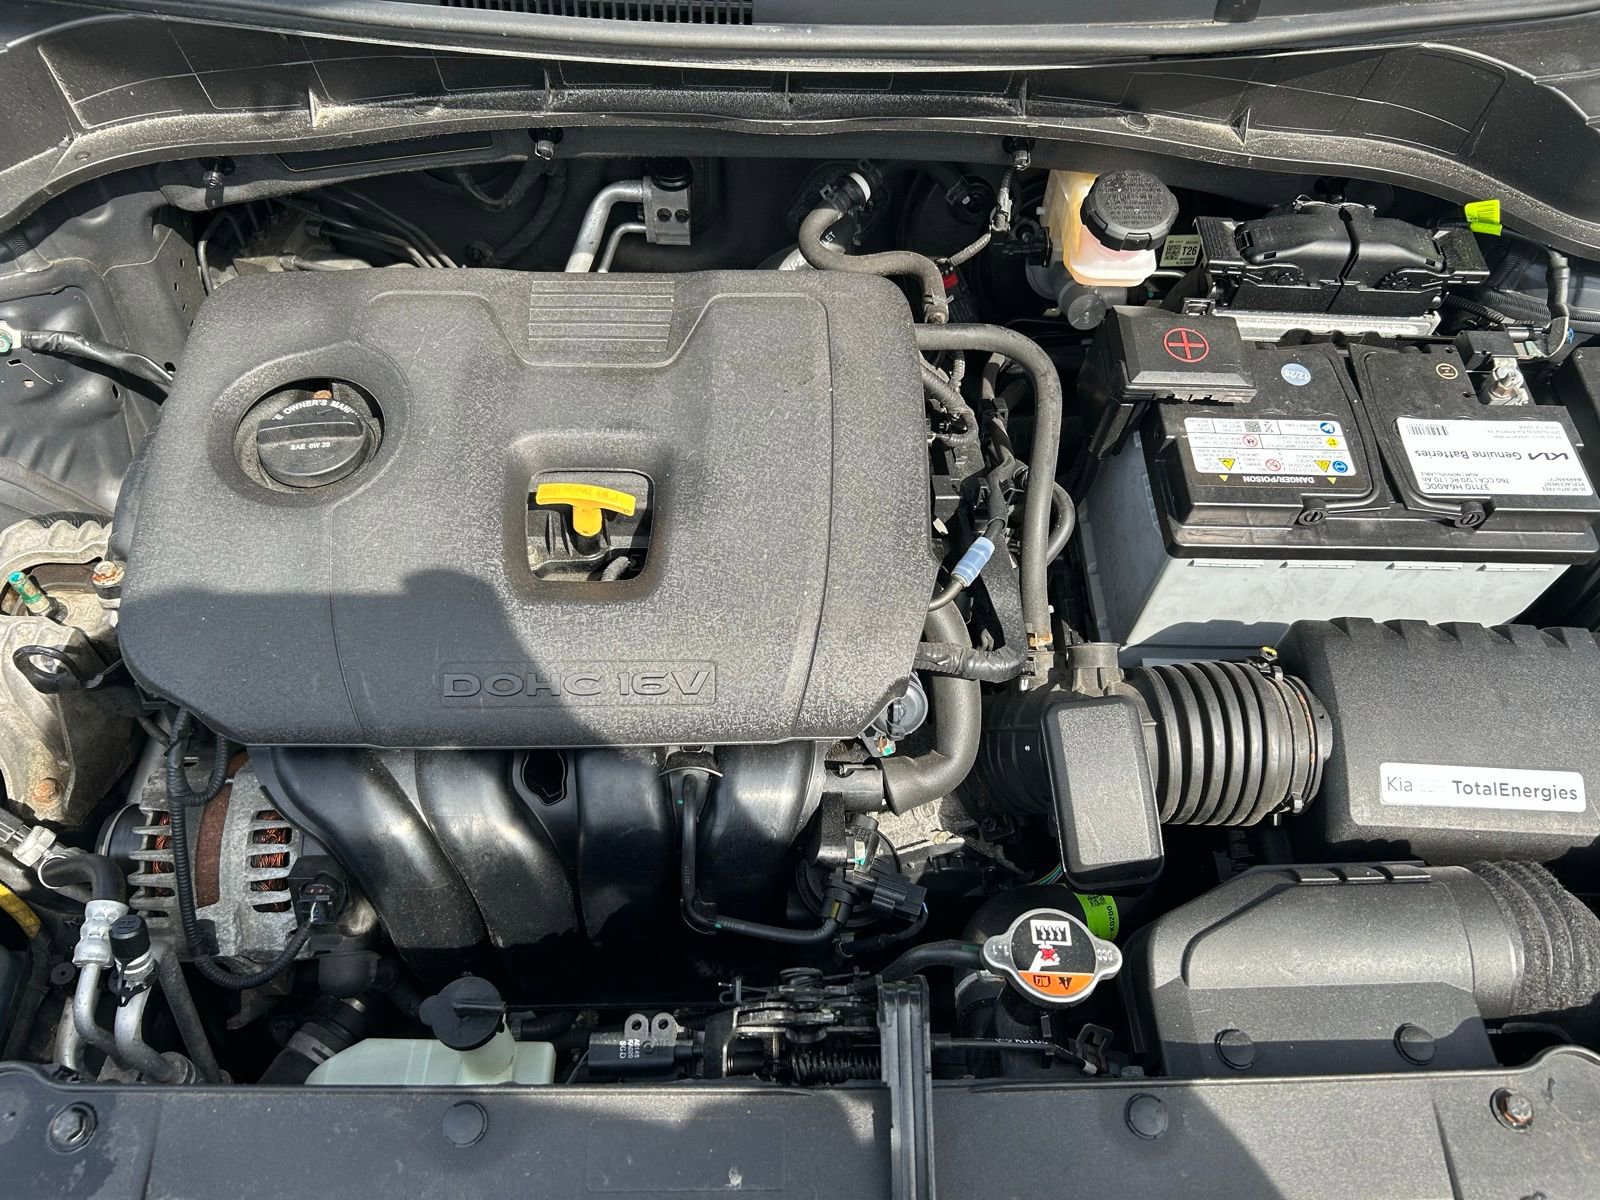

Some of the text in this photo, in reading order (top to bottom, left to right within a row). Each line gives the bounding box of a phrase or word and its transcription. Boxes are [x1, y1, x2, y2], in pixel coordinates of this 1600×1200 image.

[821, 231, 836, 245] LET
[1182, 246, 1198, 256] T26
[283, 399, 328, 415] OWNER'S
[290, 442, 306, 450] SAE
[1414, 450, 1470, 460] Batteries
[1472, 451, 1522, 461] Genuine
[1242, 475, 1315, 484] DANGER/POISON
[444, 671, 711, 698] DOHC 16V
[1386, 776, 1413, 792] Kia
[1452, 780, 1578, 802] TotalEnergies
[619, 1040, 627, 1059] SGD
